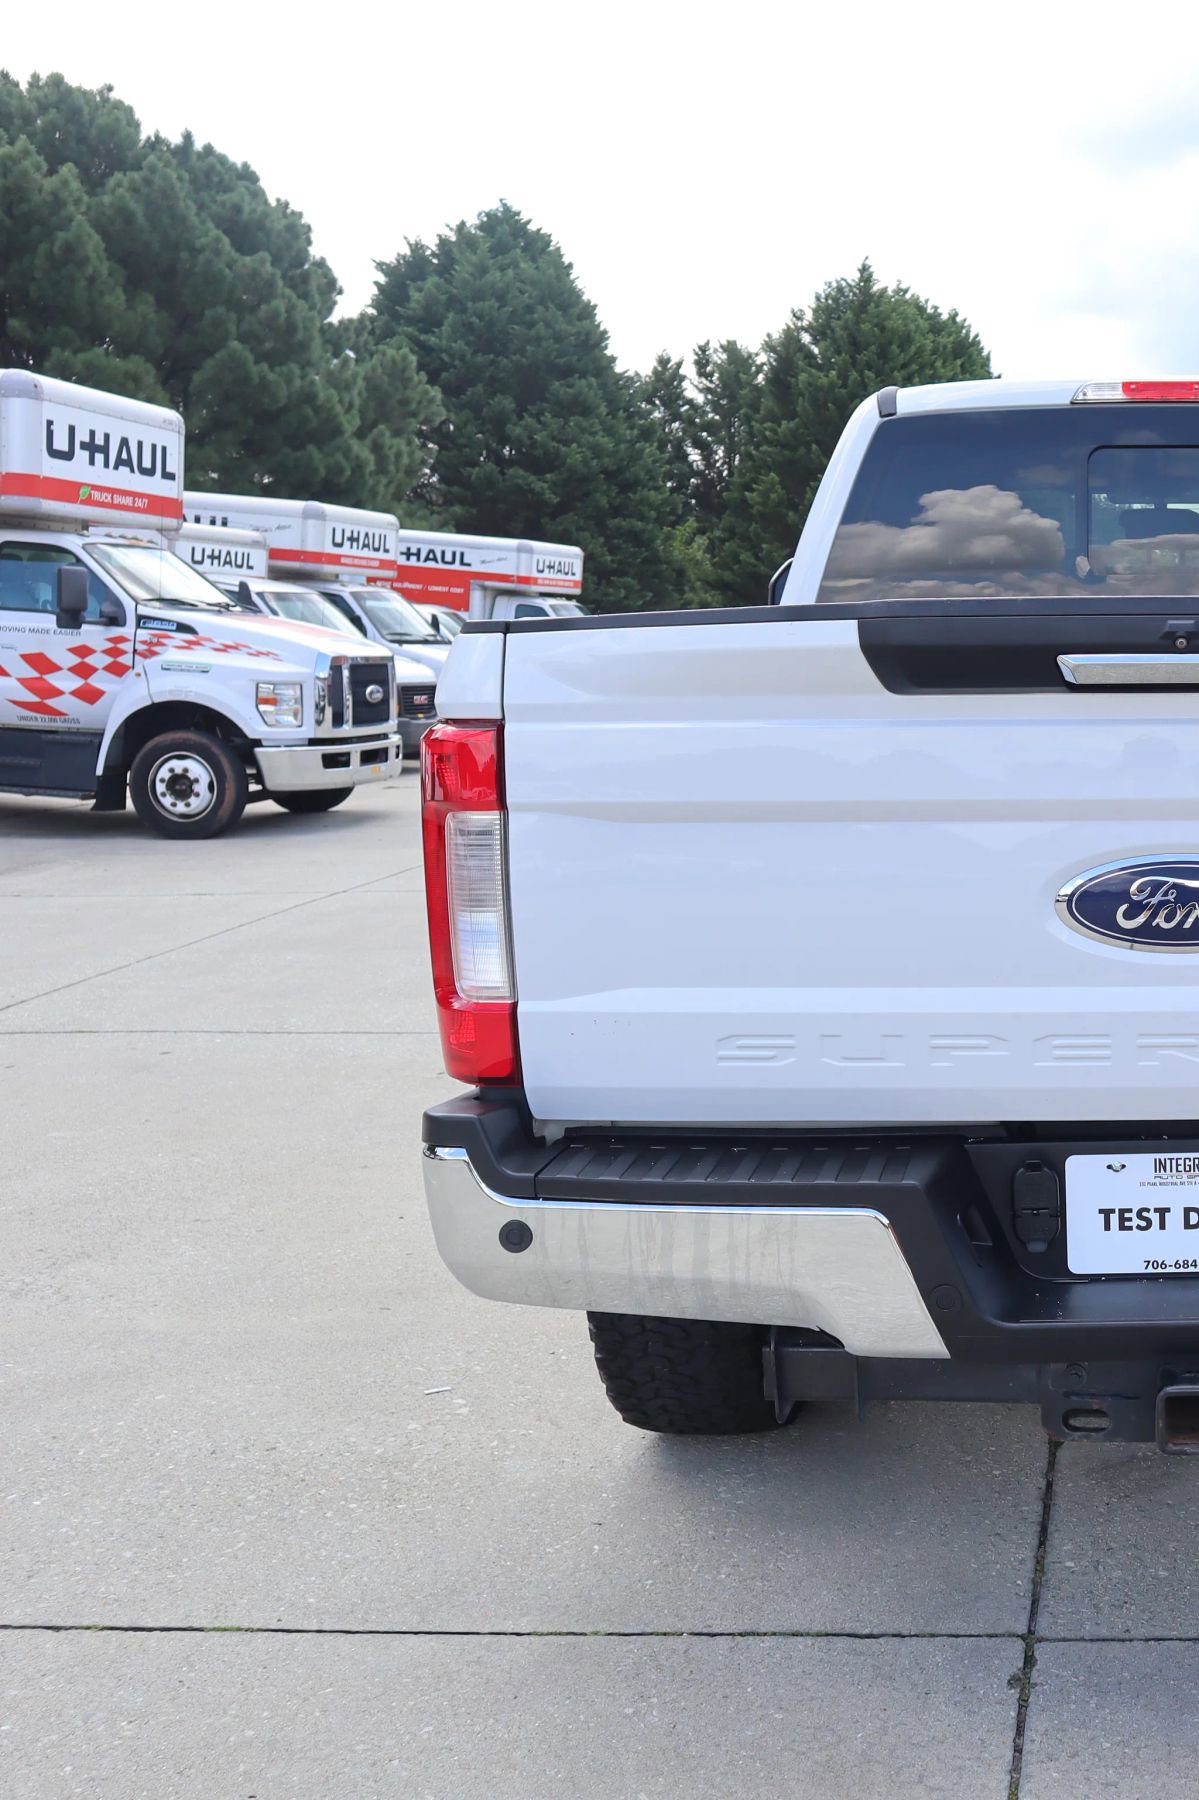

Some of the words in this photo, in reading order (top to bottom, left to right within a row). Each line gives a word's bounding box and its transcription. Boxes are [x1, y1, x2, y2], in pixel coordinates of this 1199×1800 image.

[46, 419, 176, 482] U-HAUL
[90, 489, 112, 504] TRUCK
[113, 494, 134, 507] SHARE
[134, 497, 149, 508] 24/7
[332, 526, 391, 554] U-HAUL
[190, 546, 255, 570] U-HAUL
[399, 546, 473, 567] -HAUL
[536, 558, 577, 577] U-HAUL
[28, 627, 51, 636] MADE
[53, 629, 82, 637] EASIER
[1098, 1207, 1171, 1232] TEST
